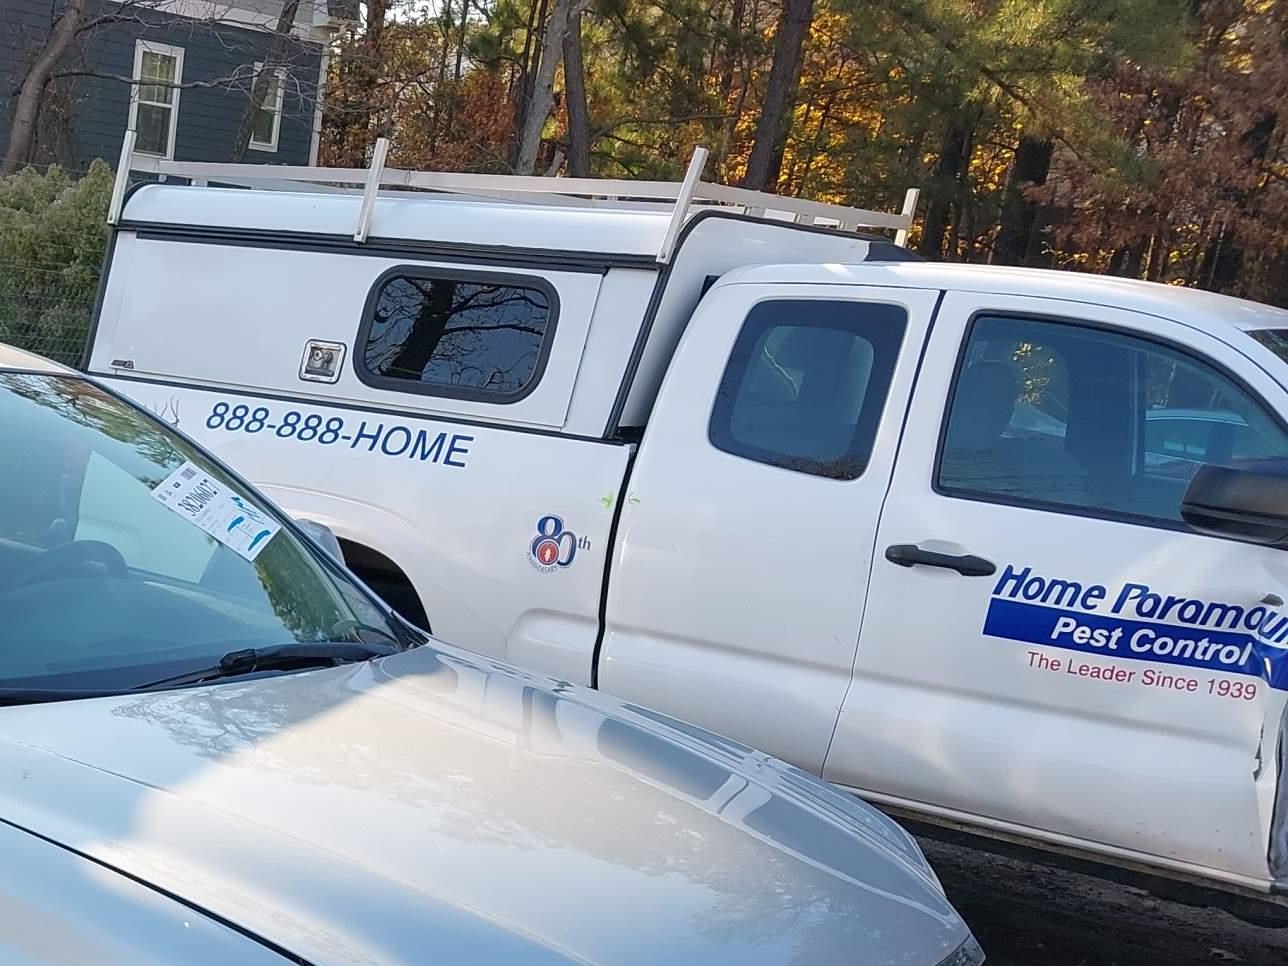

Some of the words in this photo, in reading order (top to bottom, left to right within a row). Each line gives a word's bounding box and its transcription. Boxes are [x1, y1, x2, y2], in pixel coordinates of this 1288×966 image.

[206, 401, 475, 467] 888-888-HOME
[177, 478, 221, 517] 38206027
[992, 565, 1106, 611] Home
[1050, 617, 1123, 650] Pest
[1130, 629, 1254, 667] Control
[1027, 651, 1062, 672] The
[1067, 659, 1136, 684] Leader
[1142, 670, 1199, 693] Since
[1208, 679, 1257, 702] 1939
